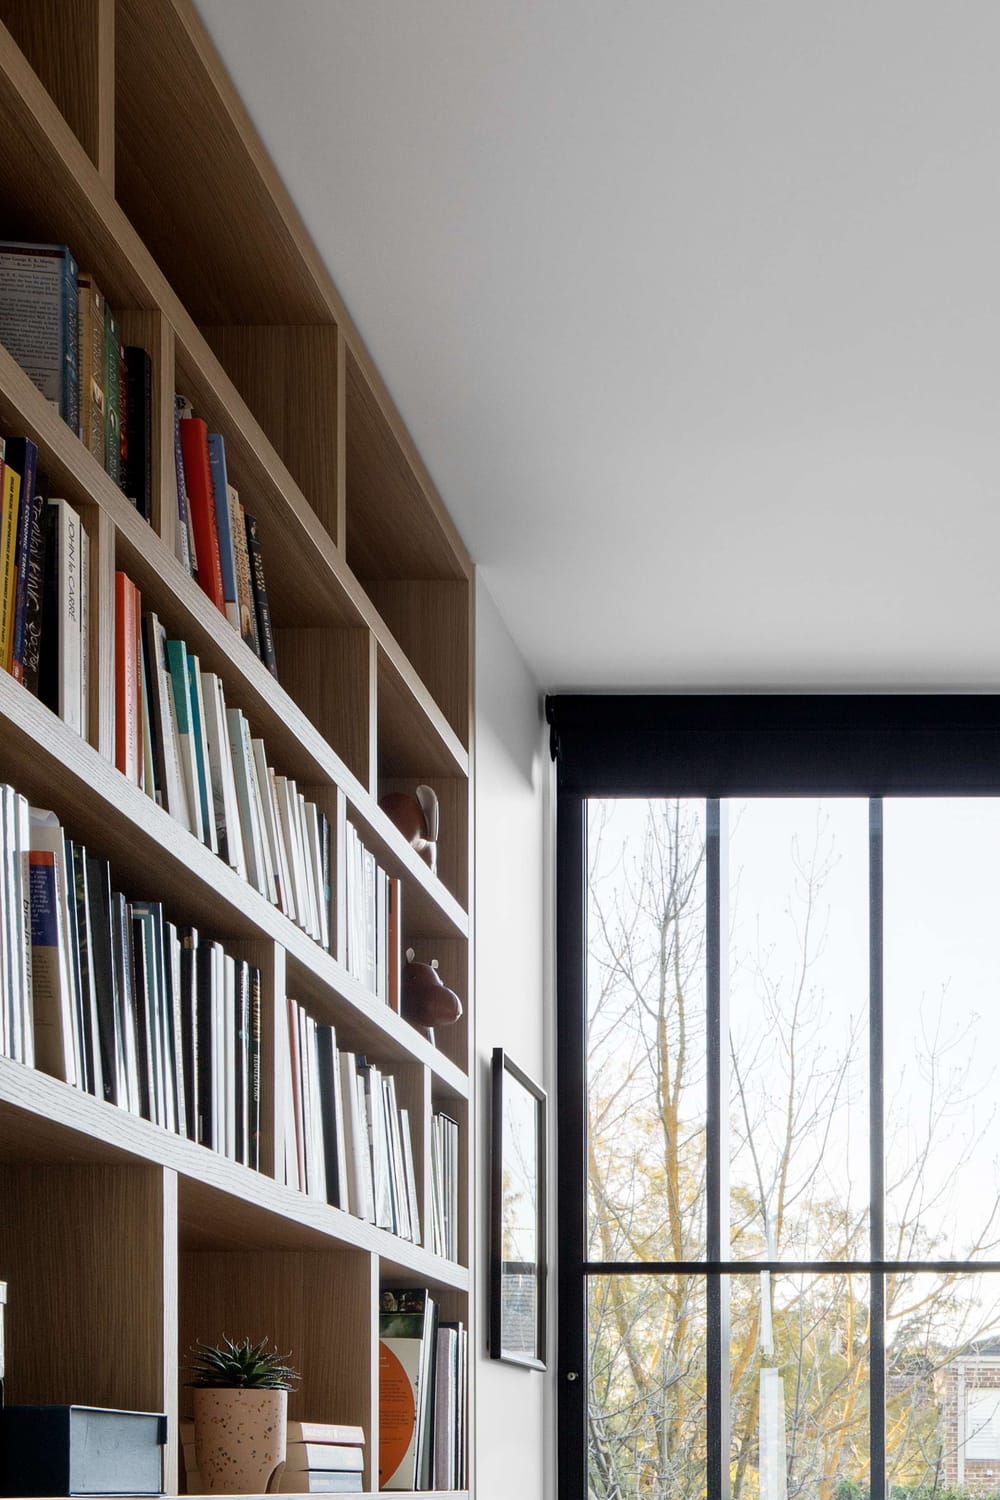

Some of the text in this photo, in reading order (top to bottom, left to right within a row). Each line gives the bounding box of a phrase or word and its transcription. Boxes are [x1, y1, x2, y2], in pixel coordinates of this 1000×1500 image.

[22, 504, 30, 550] ECONOMIC
[67, 516, 77, 622] JOHN le CARRÉ
[238, 548, 249, 599] BROWN
[27, 622, 42, 672] DOCTOR
[23, 899, 31, 947] brain
